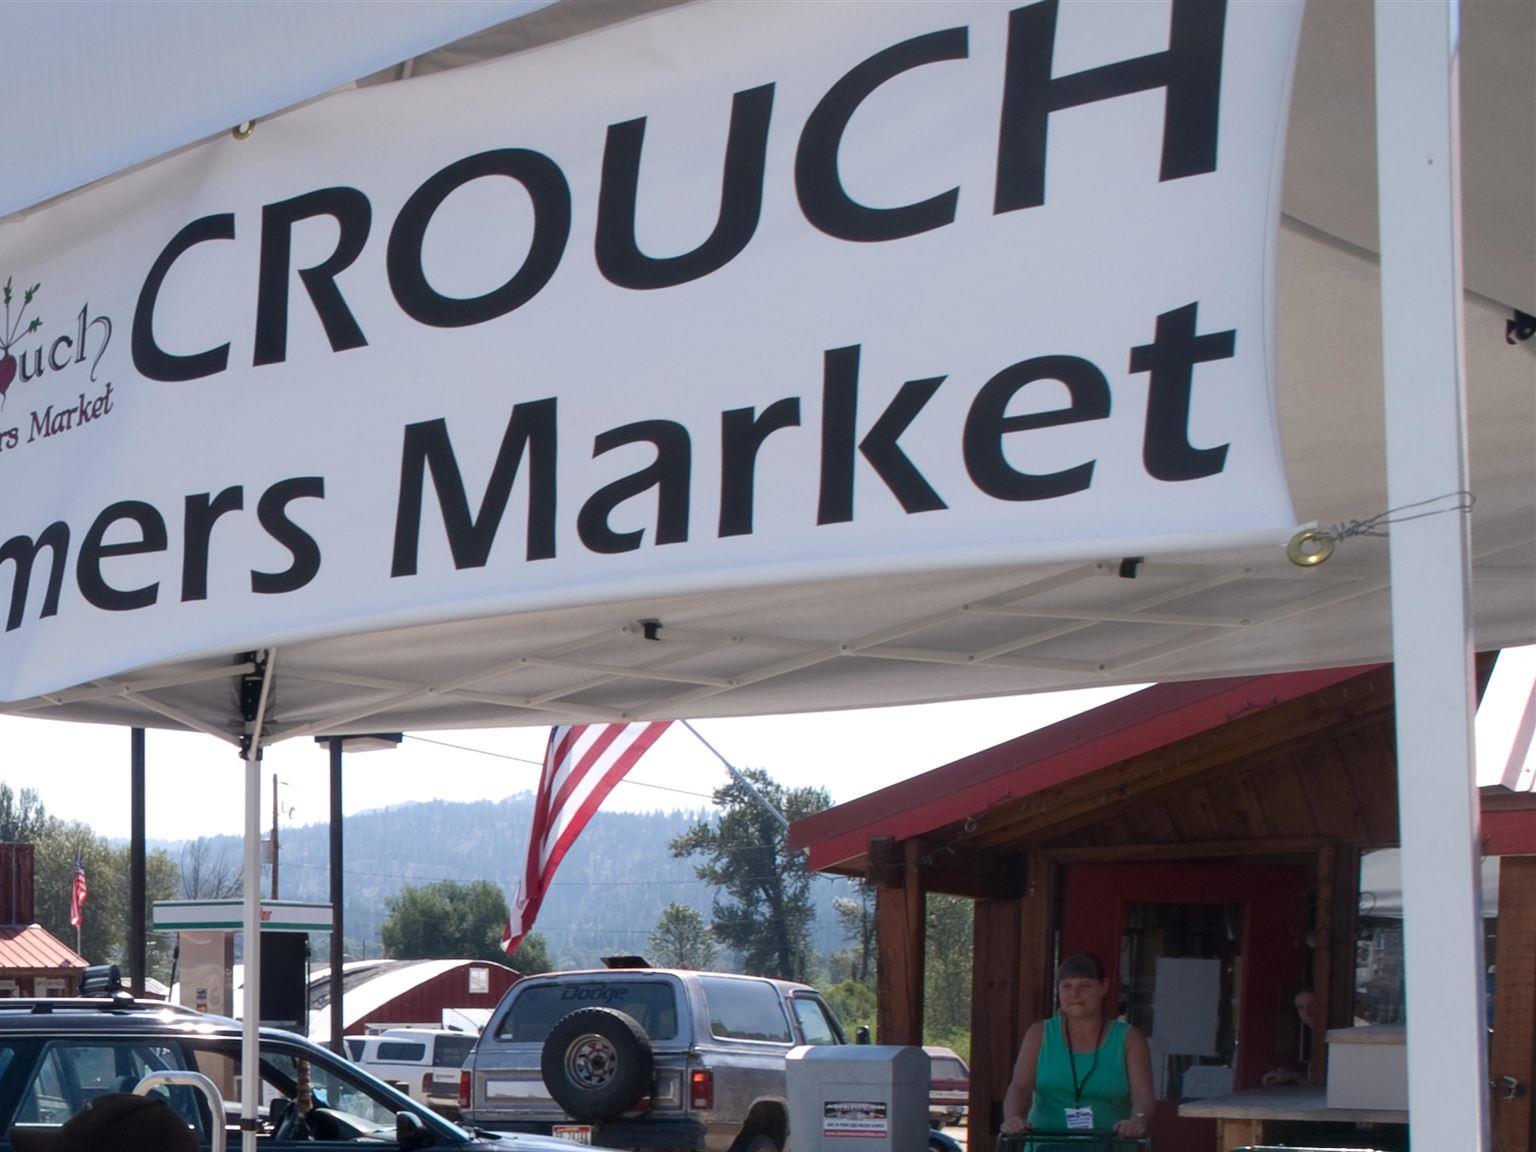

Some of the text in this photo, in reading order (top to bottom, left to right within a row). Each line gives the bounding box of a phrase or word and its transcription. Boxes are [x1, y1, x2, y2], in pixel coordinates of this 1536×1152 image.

[130, 0, 1227, 383] CROUCH
[26, 381, 114, 444] Market
[390, 300, 1237, 578] Market
[561, 982, 629, 1004] Dodge
